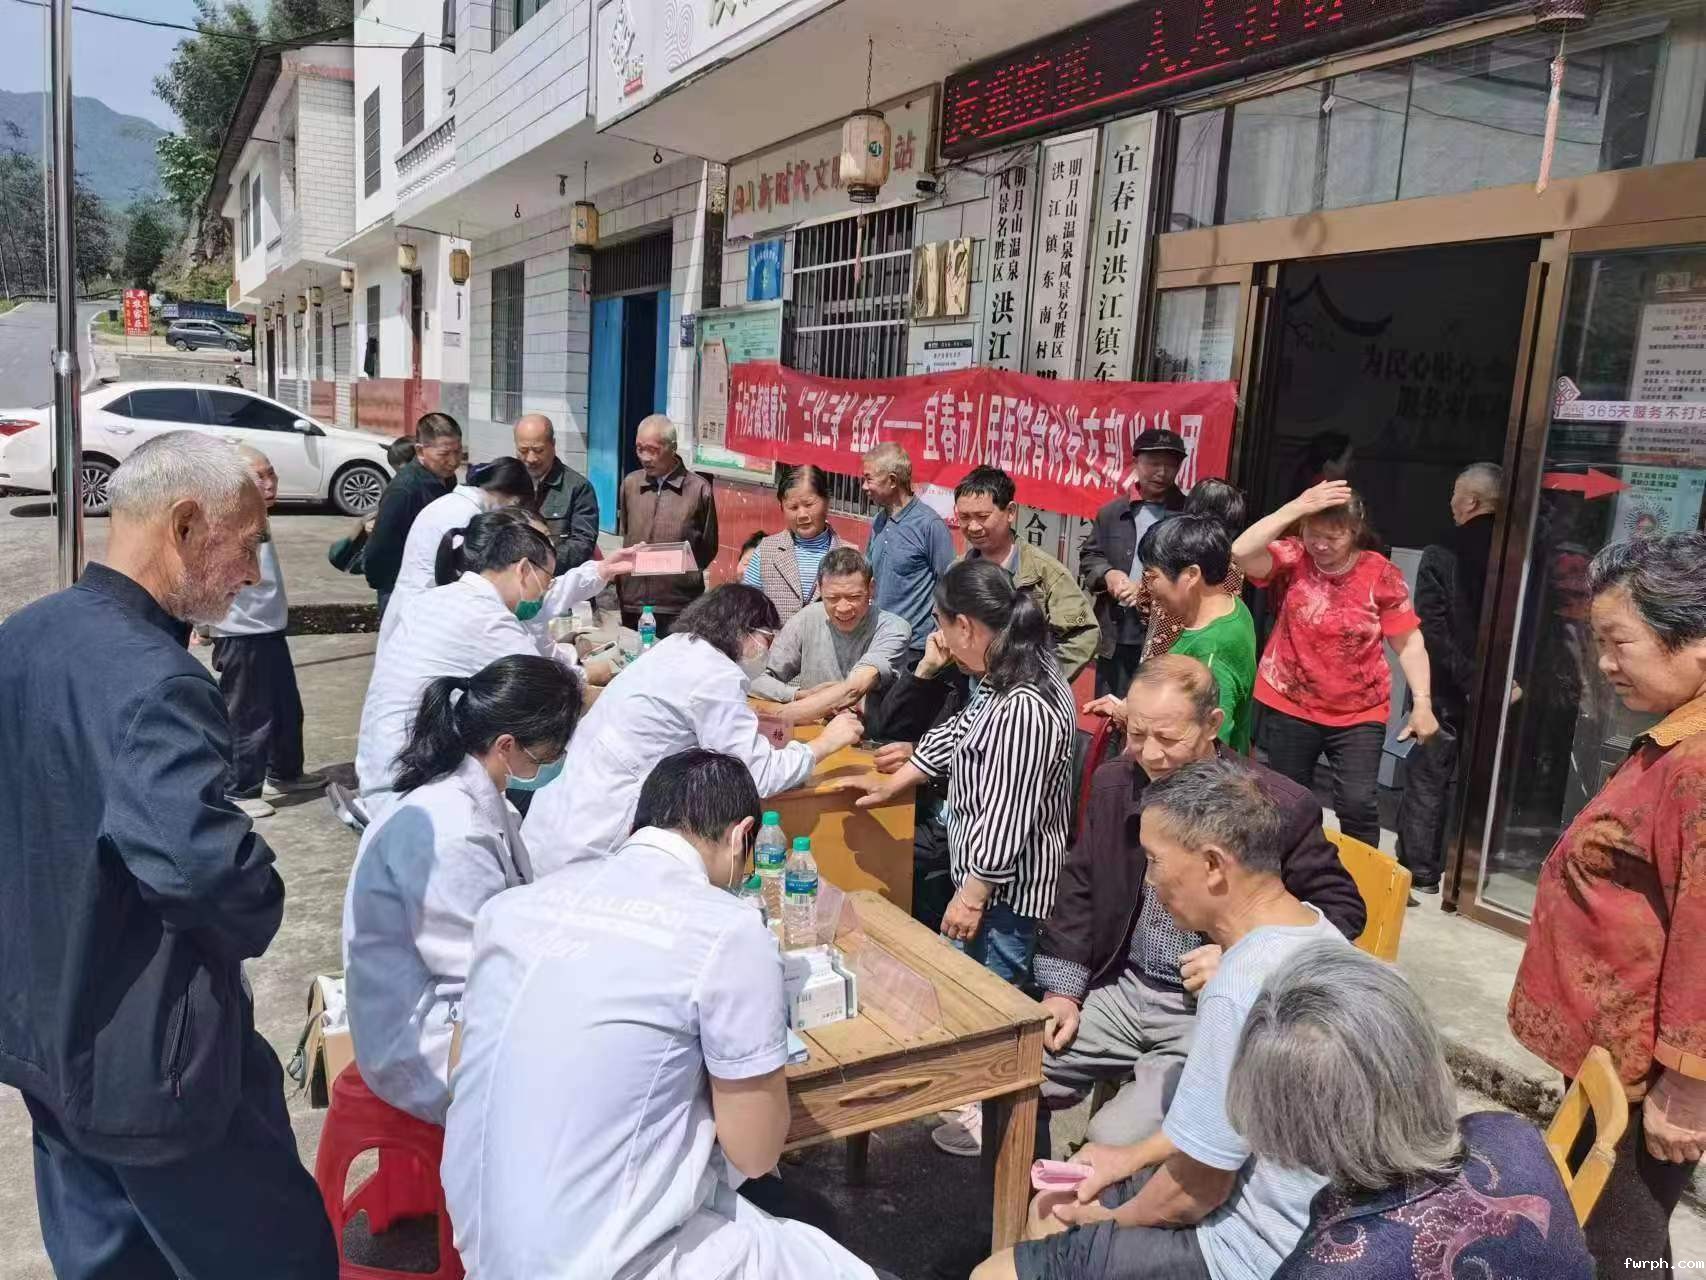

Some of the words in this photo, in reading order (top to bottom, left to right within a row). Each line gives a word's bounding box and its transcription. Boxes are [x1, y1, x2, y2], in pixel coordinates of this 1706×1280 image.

[992, 168, 1011, 283] 风景名胜区
[1007, 166, 1026, 281] 明月山温泉
[1036, 161, 1064, 359] 洪江镇东南村
[1050, 157, 1082, 358] 明月山温泉风景名胜区
[988, 291, 1015, 371] 洪江
